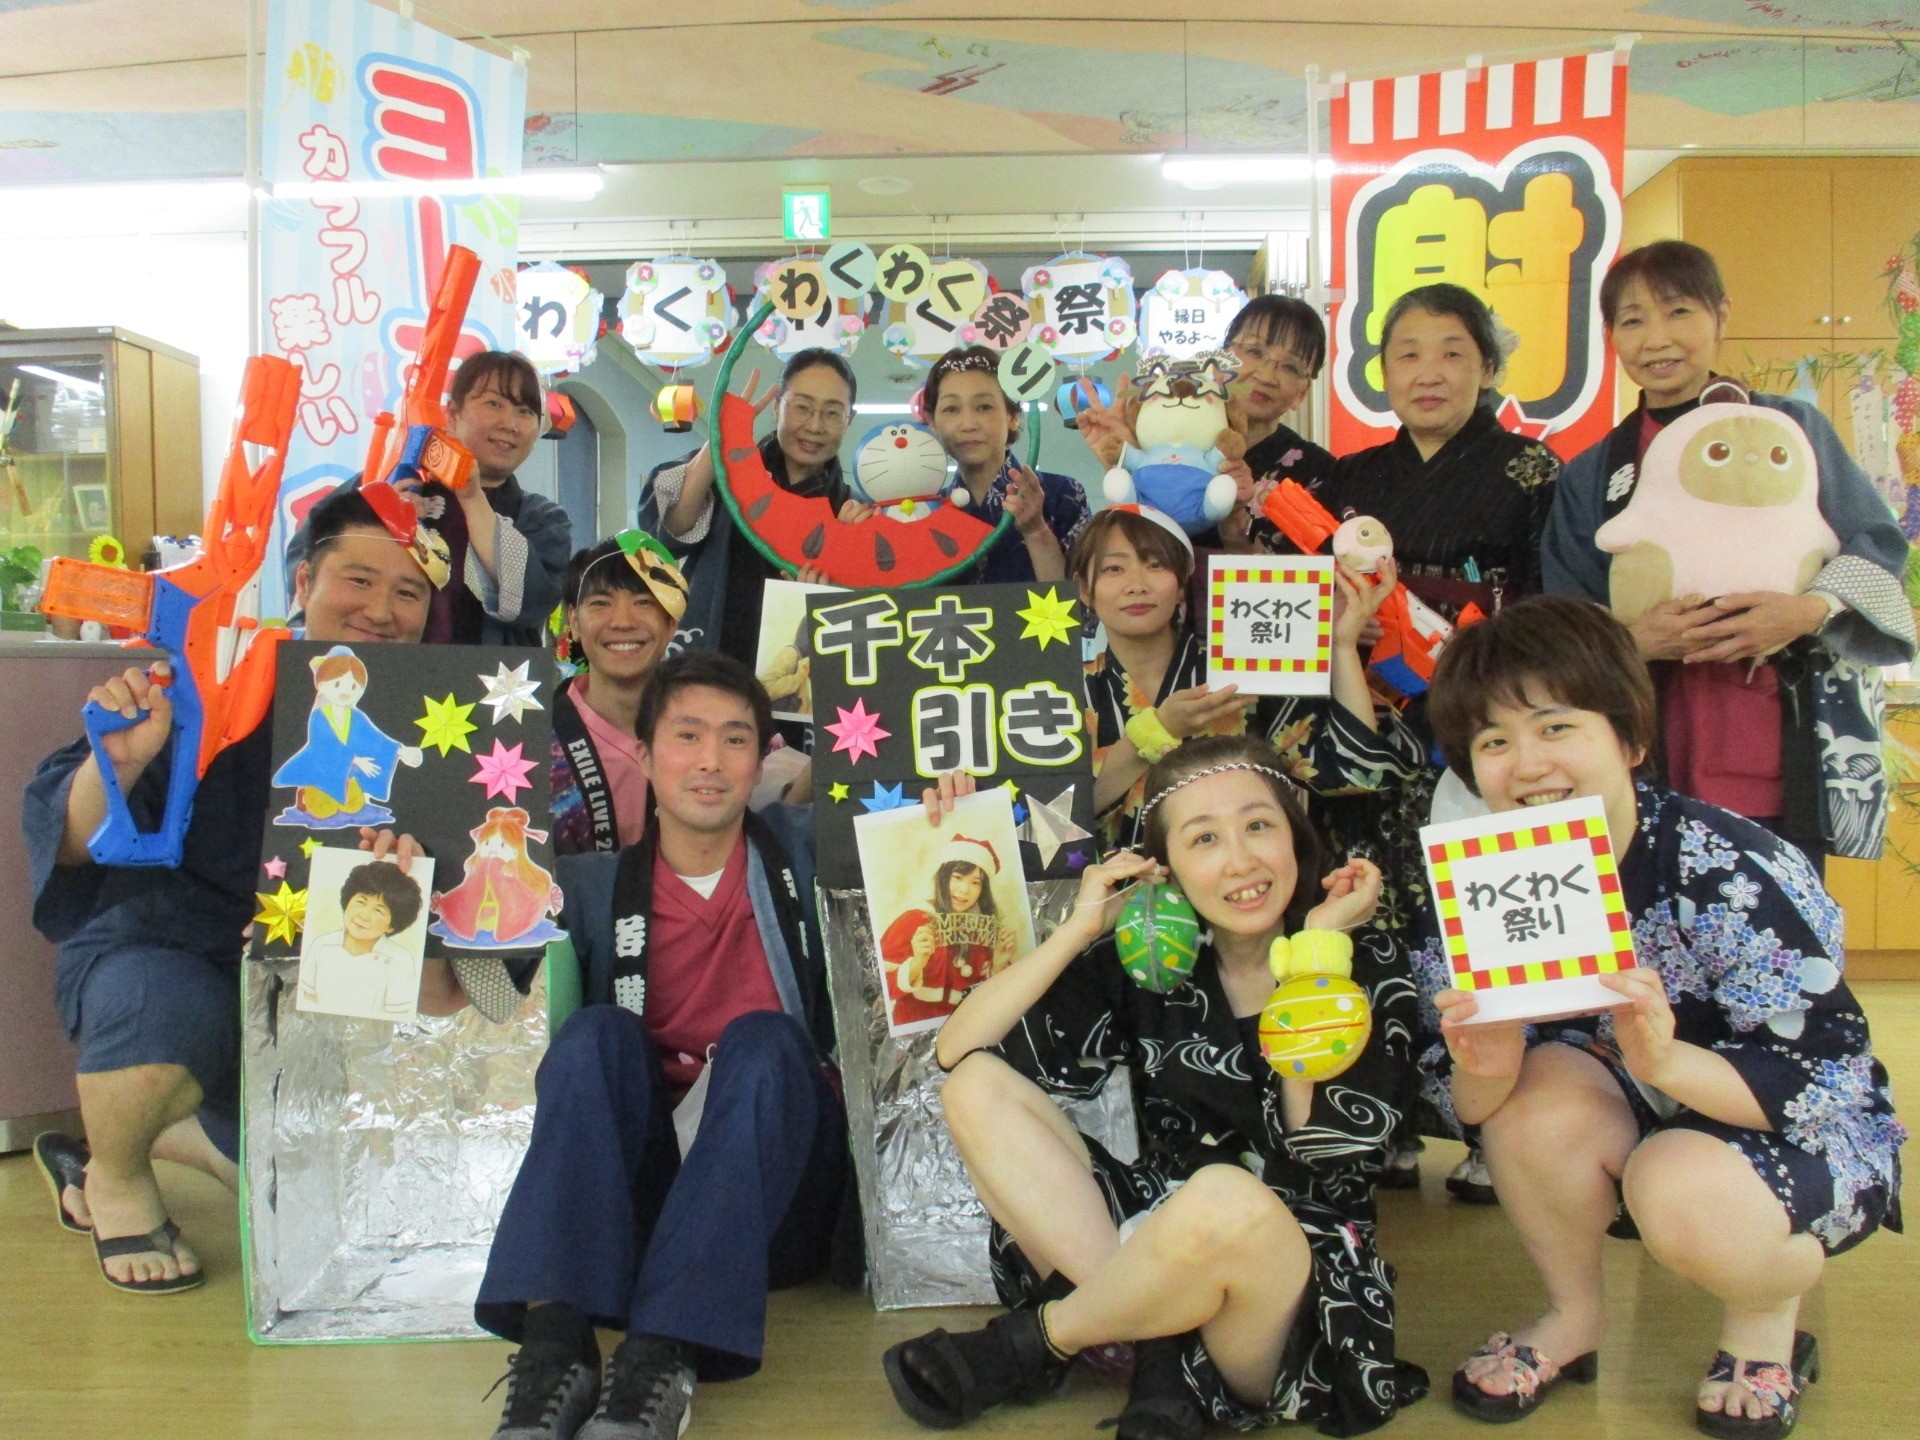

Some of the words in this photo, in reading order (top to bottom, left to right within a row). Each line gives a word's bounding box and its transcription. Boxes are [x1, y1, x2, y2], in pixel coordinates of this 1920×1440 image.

[298, 124, 381, 325] カラフル
[1054, 284, 1107, 336] 祭
[269, 293, 359, 447] 楽しい
[1229, 598, 1313, 621] わくわく
[1250, 621, 1291, 645] 祭り
[813, 594, 996, 686] 千本
[911, 681, 1083, 779] 引き
[567, 738, 602, 788] EXILE
[588, 790, 611, 834] LIVE
[595, 837, 614, 855] 2
[1464, 863, 1591, 912] わくわく
[1502, 903, 1566, 943] 祭り
